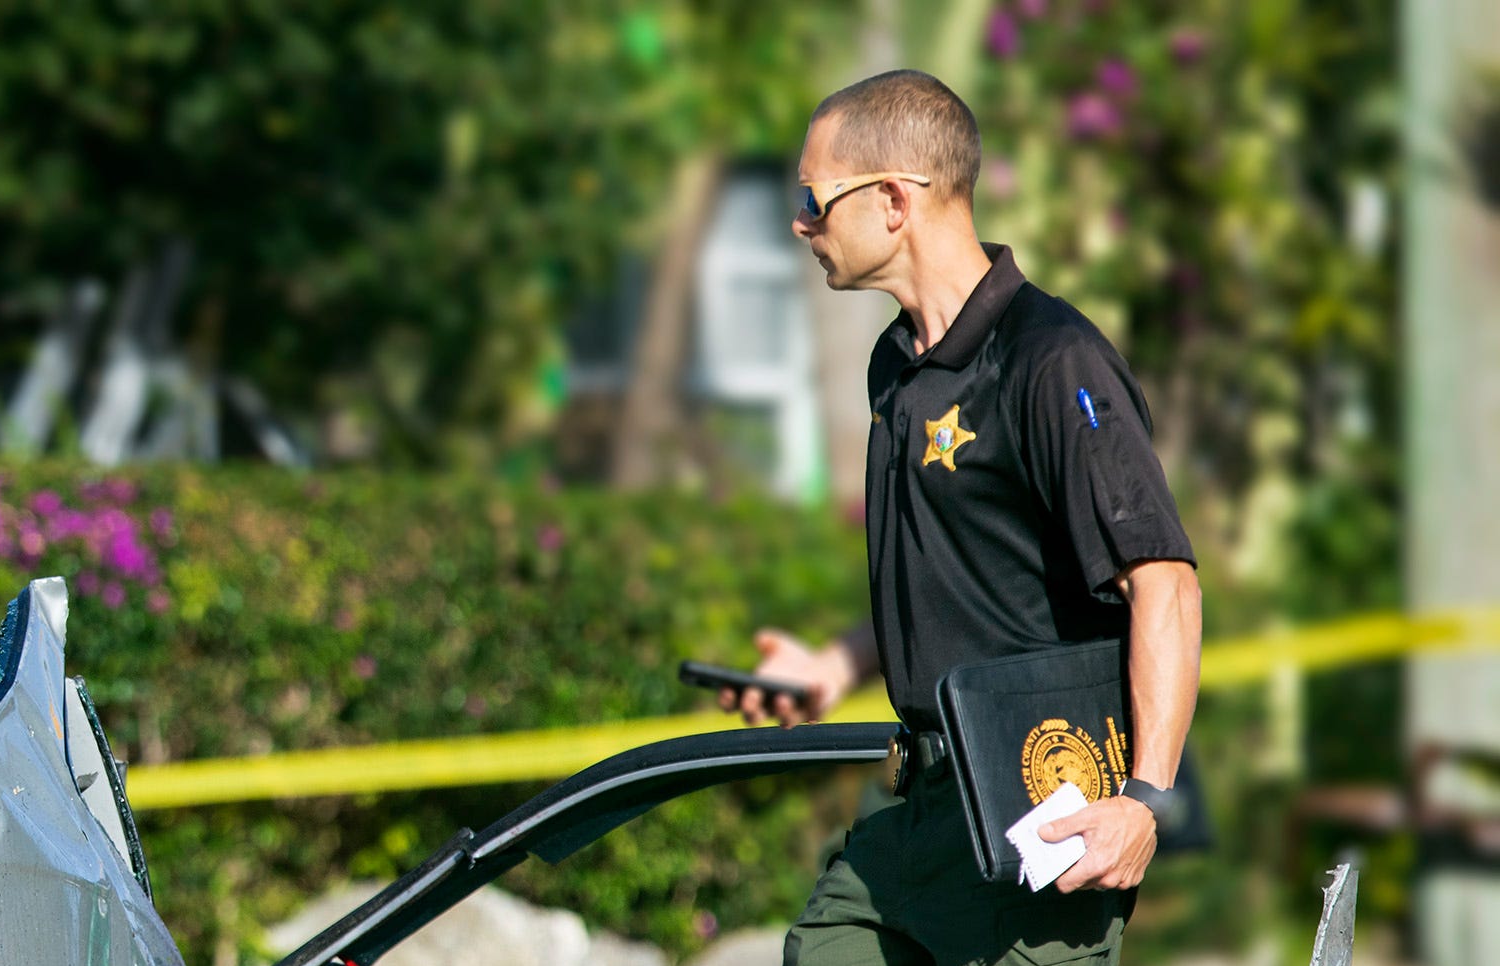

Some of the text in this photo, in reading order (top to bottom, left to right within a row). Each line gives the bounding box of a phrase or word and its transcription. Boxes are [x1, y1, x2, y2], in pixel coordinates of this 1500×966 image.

[1022, 726, 1041, 766] COUNTY
[1076, 726, 1103, 761] OFFICE
[1099, 762, 1111, 798] RIFF'S
